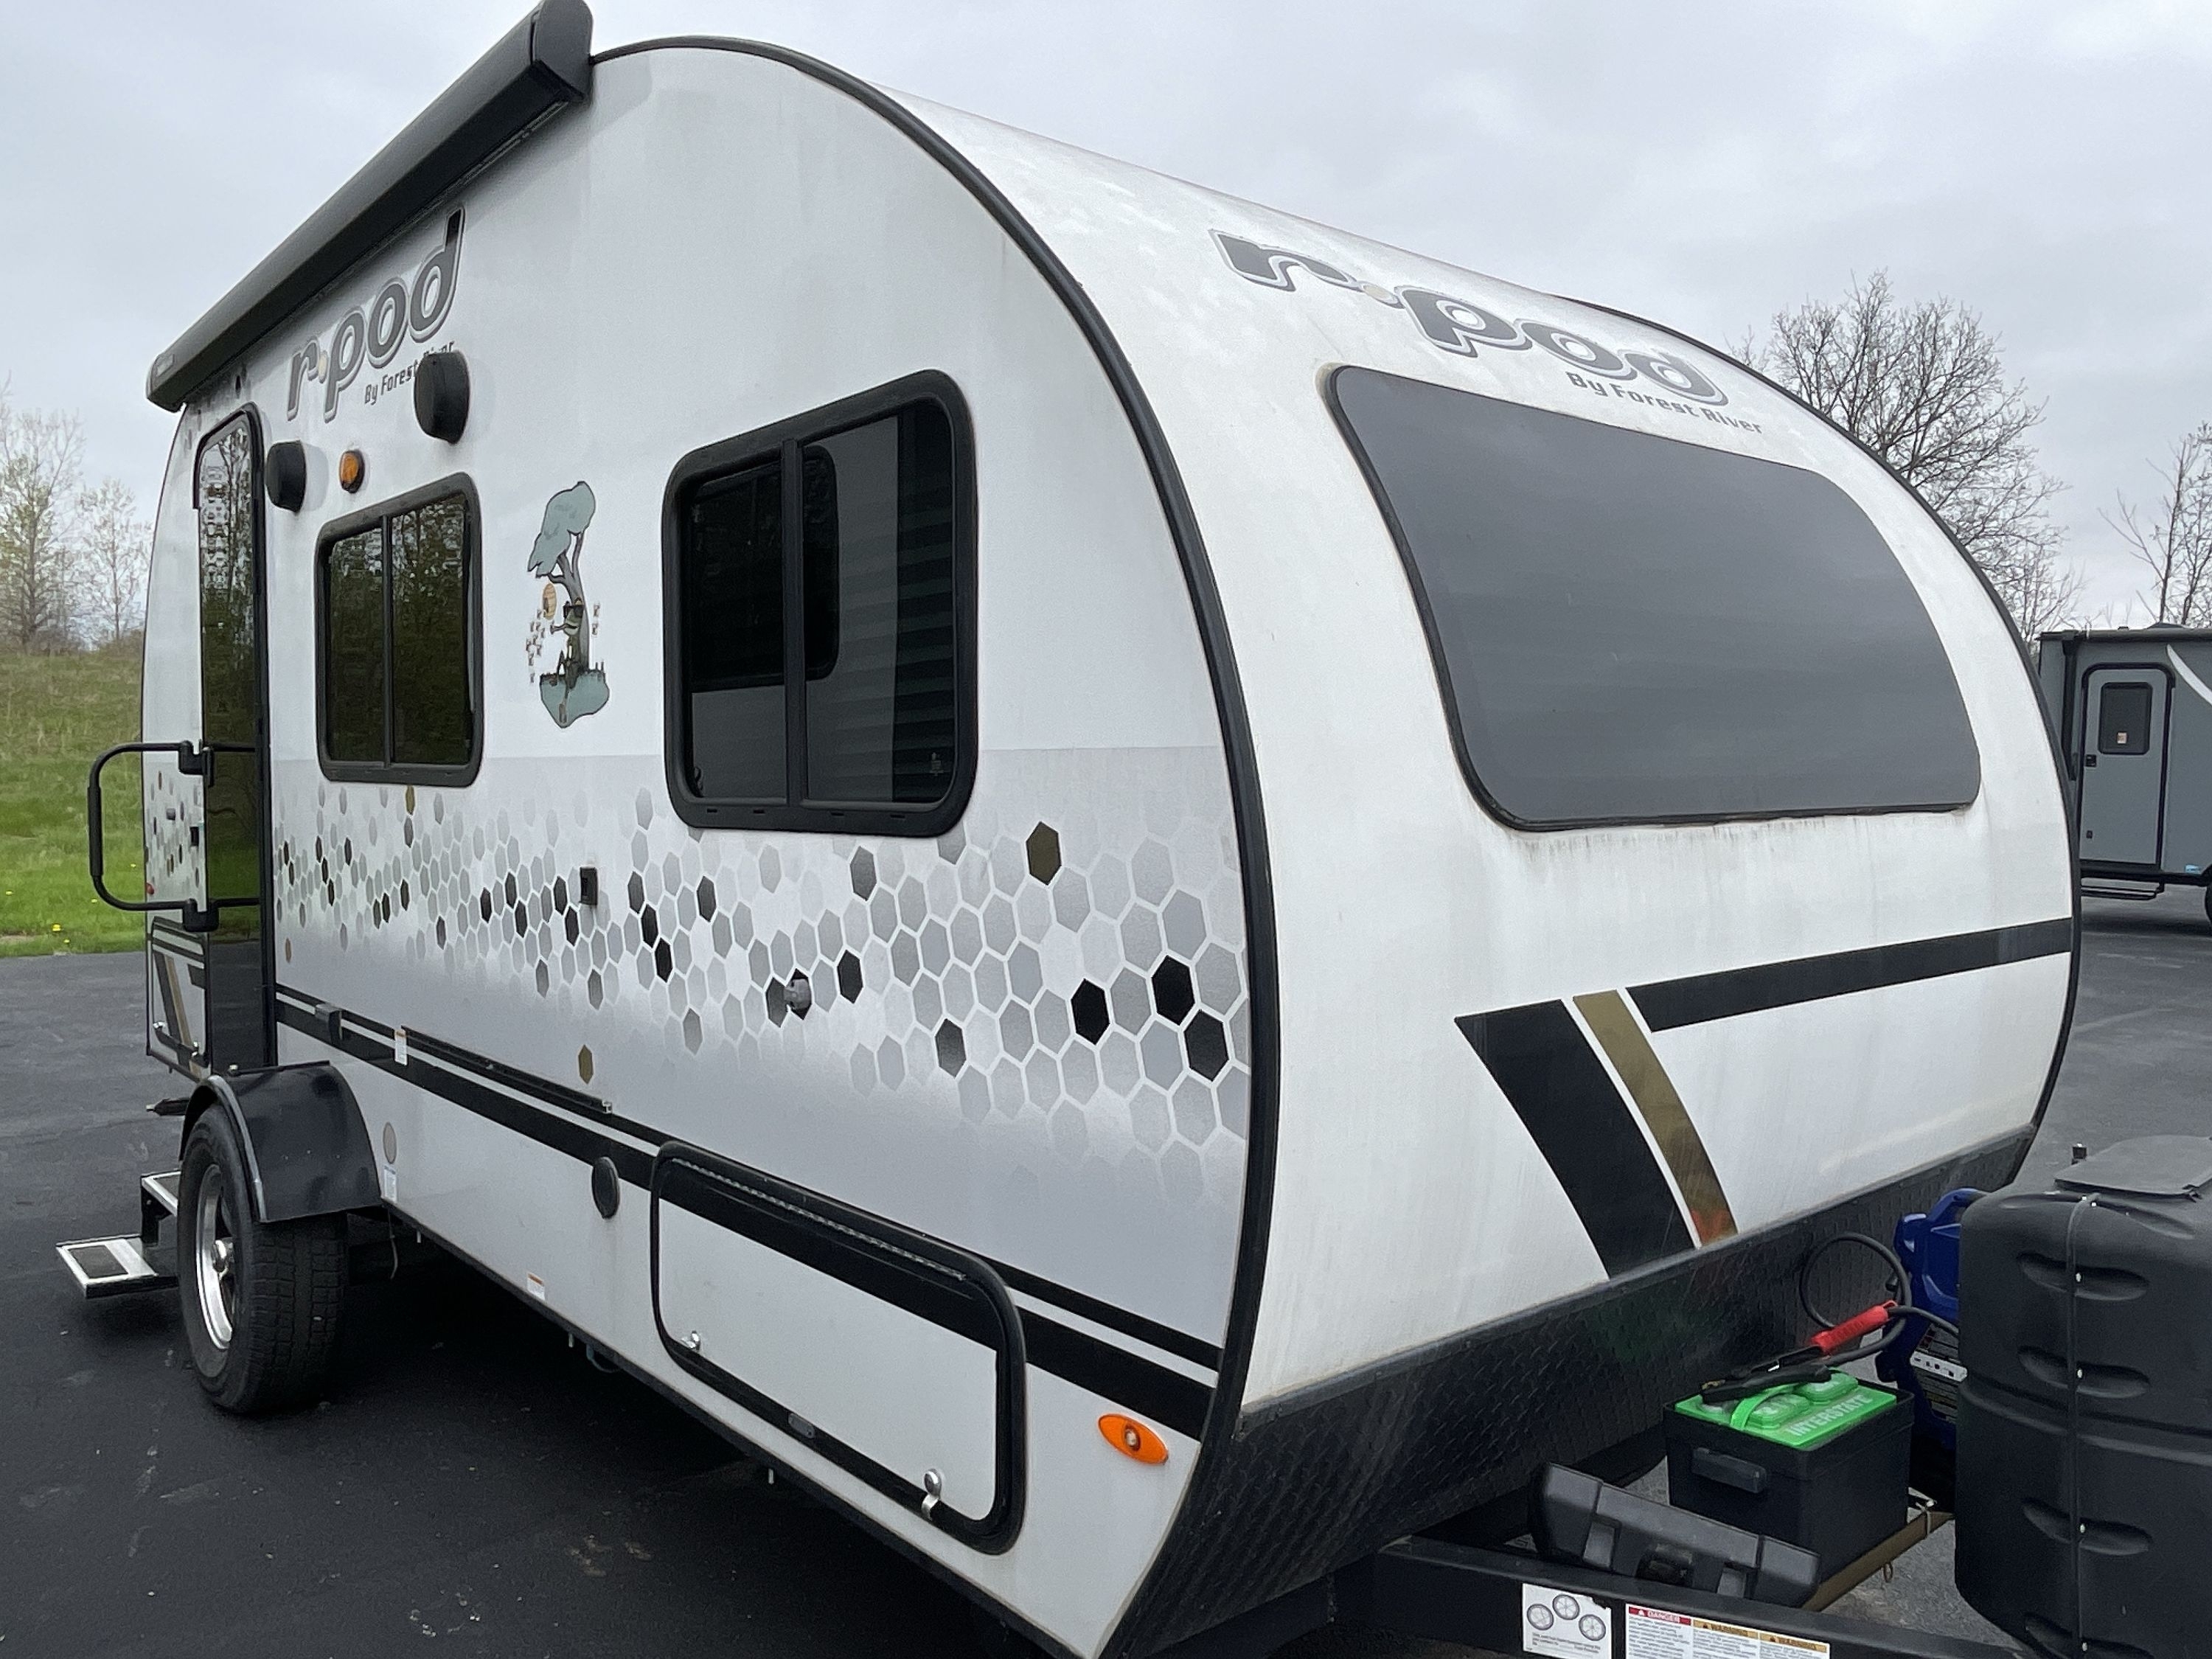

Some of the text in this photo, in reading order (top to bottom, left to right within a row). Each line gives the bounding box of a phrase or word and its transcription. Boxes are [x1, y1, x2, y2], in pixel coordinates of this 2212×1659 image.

[364, 359, 418, 406] By Forest
[1565, 371, 1763, 435] By Forest River
[1785, 1394, 1874, 1437] INTERSTATE
